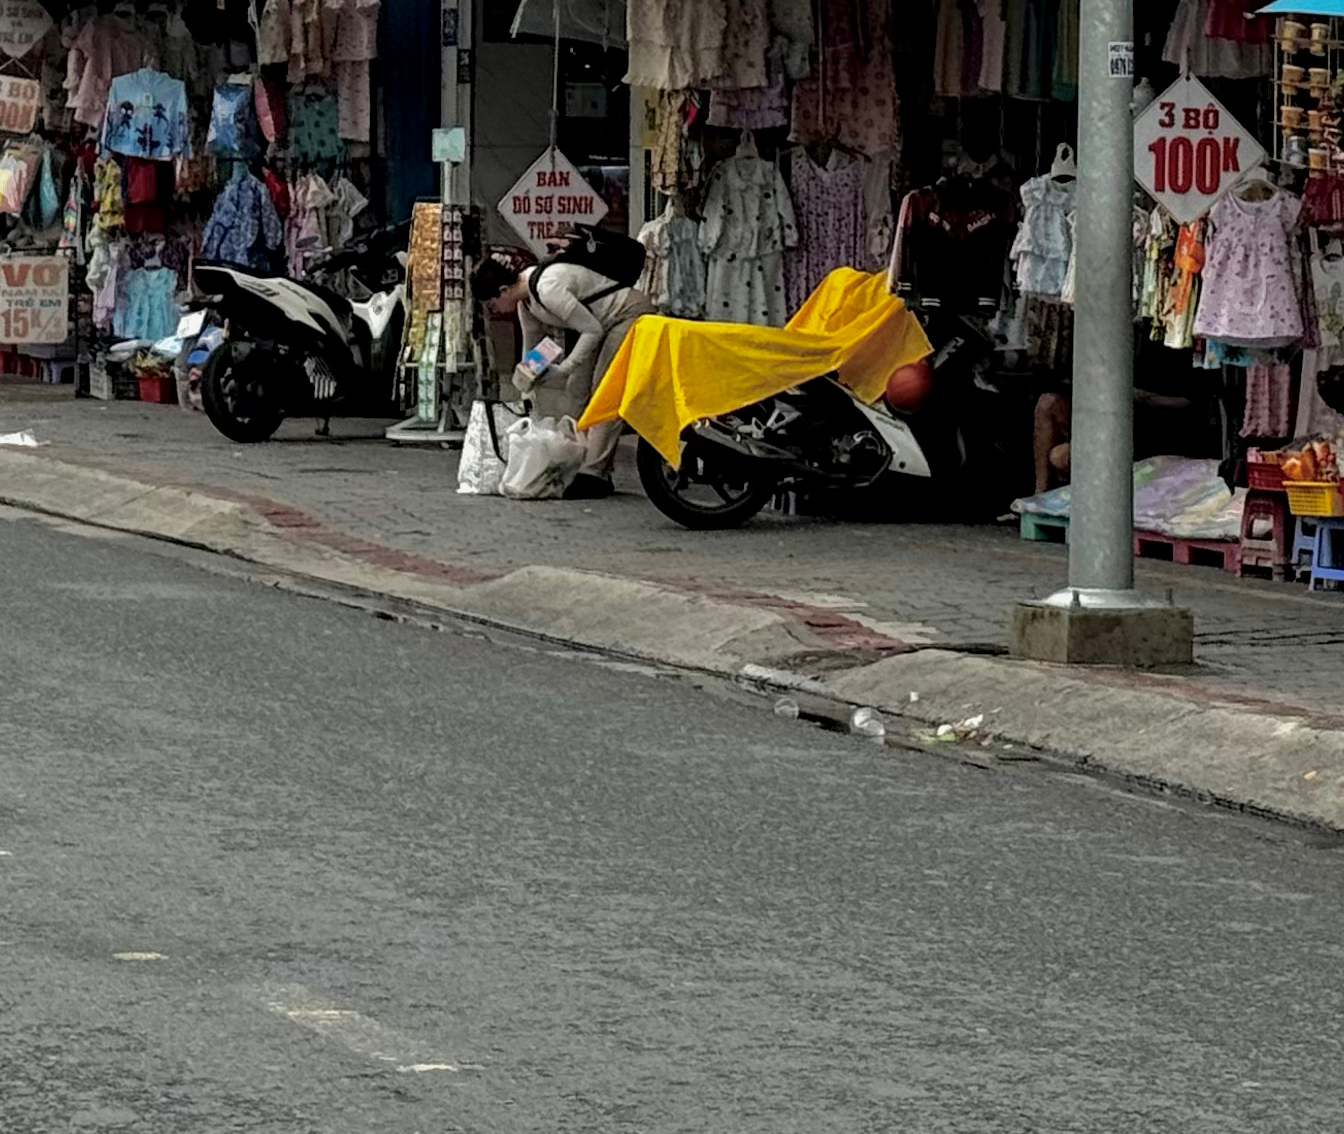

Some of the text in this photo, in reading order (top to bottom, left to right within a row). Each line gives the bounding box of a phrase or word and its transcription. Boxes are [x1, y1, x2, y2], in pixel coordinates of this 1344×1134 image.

[1158, 102, 1220, 135] 3 BỘ
[1148, 136, 1241, 195] 100K
[557, 196, 595, 215] SINH
